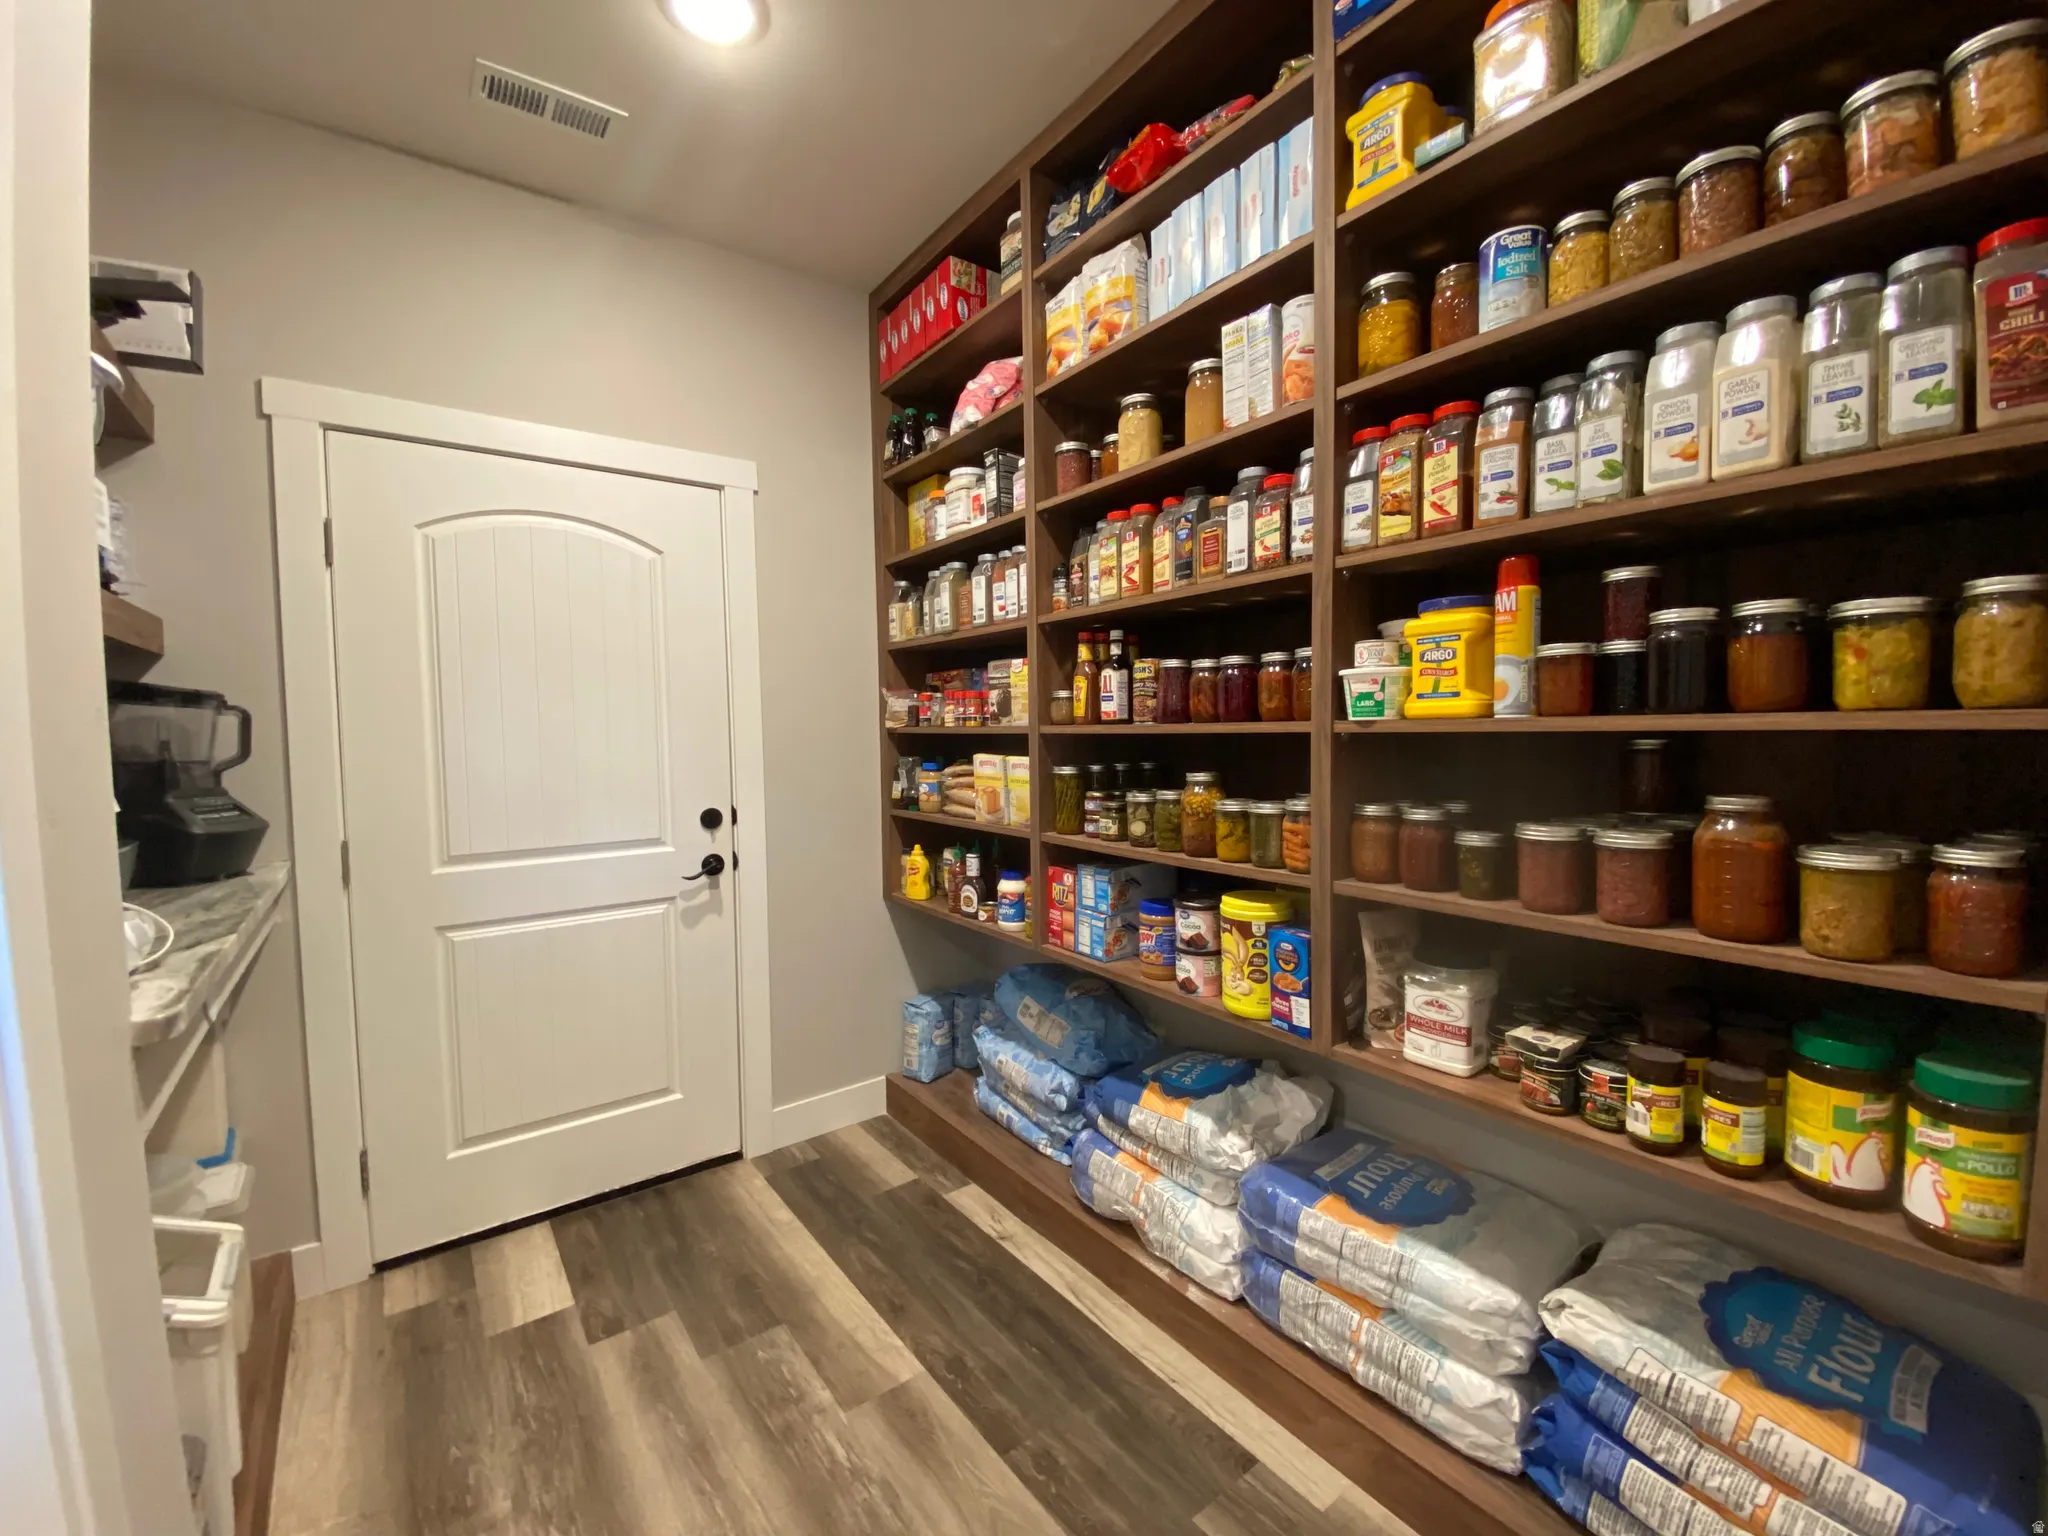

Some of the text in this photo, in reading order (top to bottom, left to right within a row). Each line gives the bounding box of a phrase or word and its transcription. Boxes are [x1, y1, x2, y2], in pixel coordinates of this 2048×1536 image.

[1363, 126, 1391, 149] ARGO
[1500, 230, 1532, 245] Great
[1508, 240, 1532, 249] Value
[1498, 250, 1536, 268] Iodized
[1505, 263, 1529, 277] Salt
[1999, 310, 2045, 331] CHILI
[1824, 360, 1855, 373] THYME
[1727, 375, 1758, 391] GARLIC
[1822, 369, 1855, 384] LEAVES
[1724, 383, 1761, 399] POWDER
[1659, 398, 1689, 412] ONION
[1656, 406, 1691, 421] POWDER
[1496, 589, 1516, 613] AM
[1423, 648, 1453, 662] ARGO
[1052, 883, 1069, 902] RITZ
[1409, 1014, 1441, 1030] WHOLE
[1444, 1024, 1468, 1035] MILK
[1660, 1100, 1677, 1108] RES
[1714, 1114, 1731, 1125] RES
[1347, 1152, 1414, 1200] Flour
[1967, 1160, 2016, 1176] POLLO
[1379, 1170, 1424, 1211] Purpose
[1773, 1293, 1826, 1374] All Purpose
[1807, 1311, 1884, 1404] Flour
